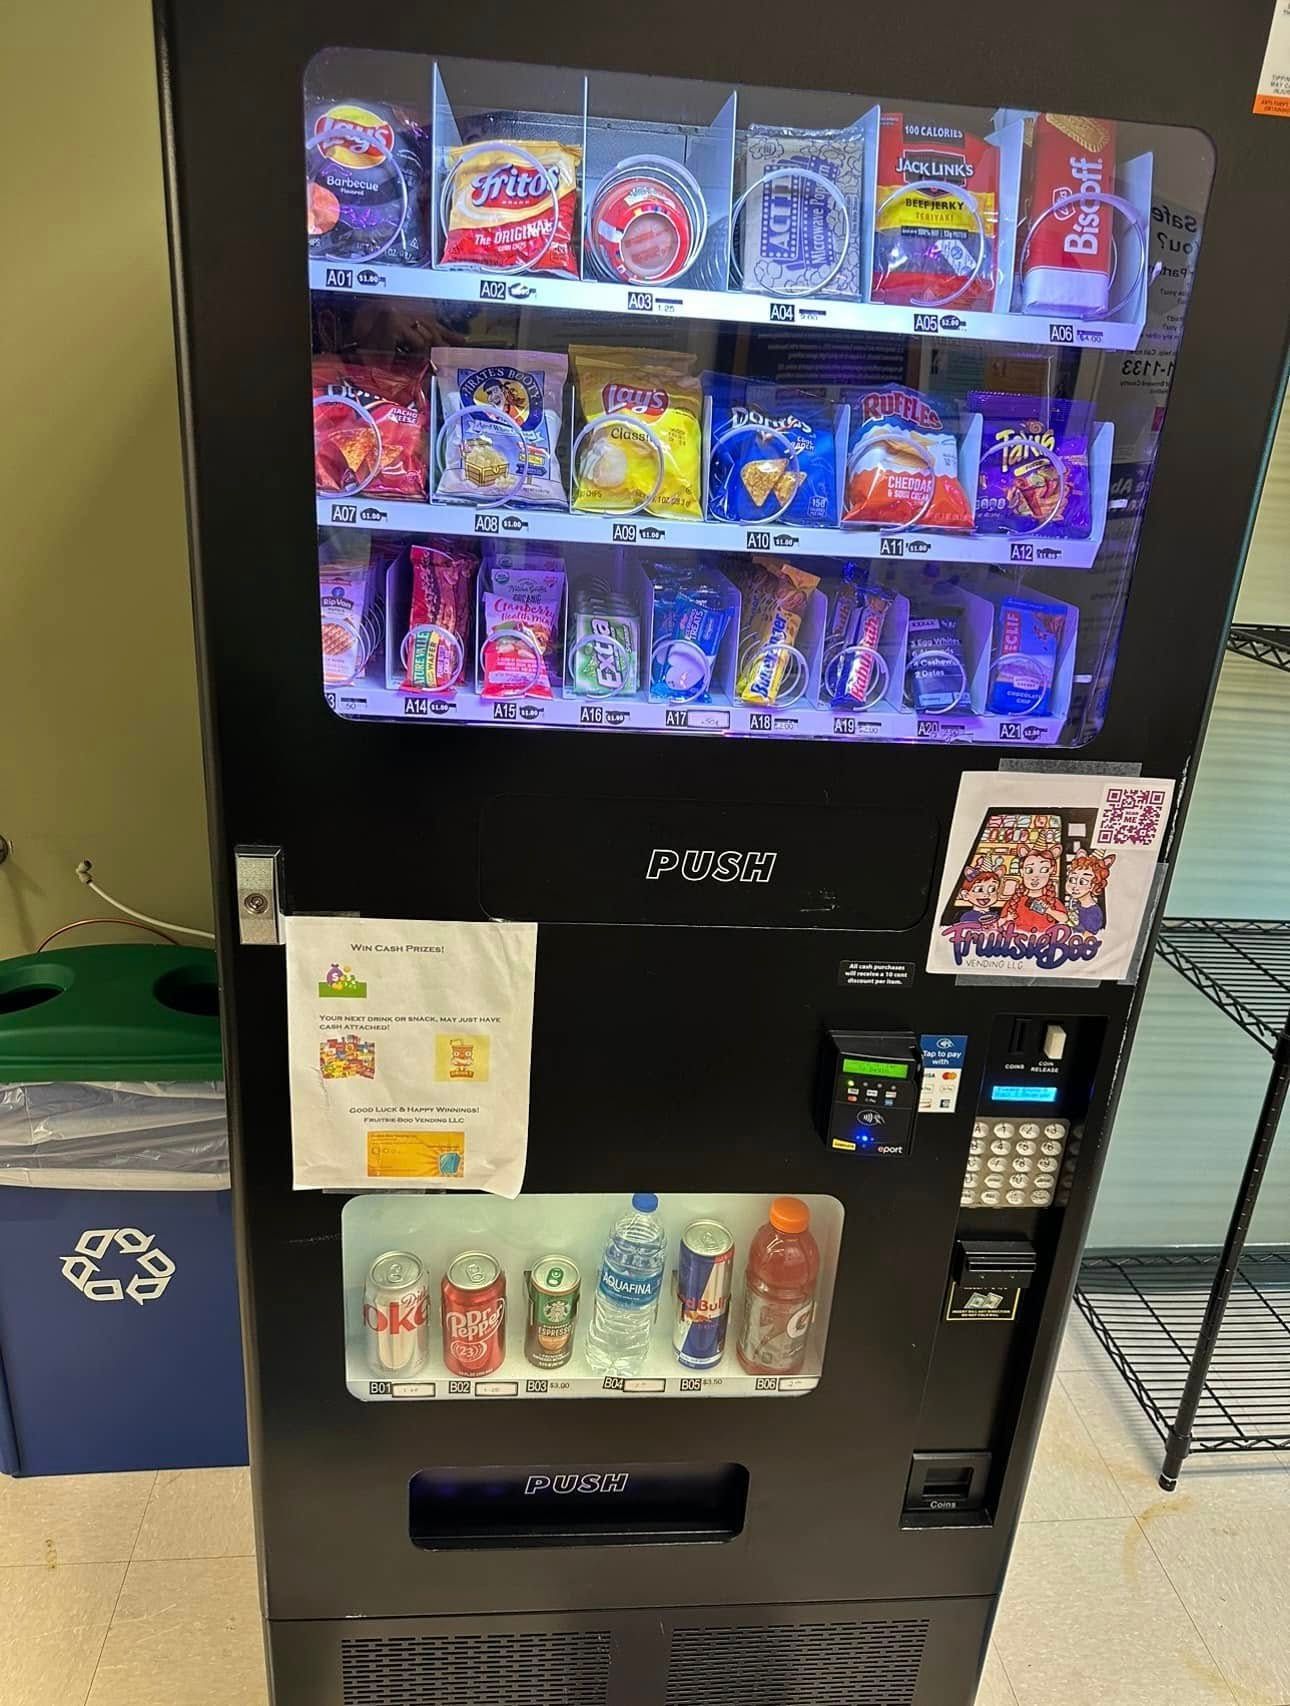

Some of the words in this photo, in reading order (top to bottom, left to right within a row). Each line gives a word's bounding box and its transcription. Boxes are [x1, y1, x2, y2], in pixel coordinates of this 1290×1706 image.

[905, 125, 920, 137] 100
[921, 126, 963, 139] CALORIES
[896, 157, 931, 176] JACK
[931, 158, 974, 178] LINK'S
[326, 175, 380, 192] Barbecue
[472, 163, 561, 207] Fritos
[905, 198, 930, 210] BEEF
[931, 200, 964, 211] JERKY
[1063, 157, 1103, 255] Biscoff
[768, 199, 792, 250] ACT
[474, 233, 491, 246] The
[810, 207, 828, 265] Microwave
[327, 271, 352, 287] A01
[481, 283, 505, 298] A02
[629, 294, 652, 309] A03
[770, 306, 794, 320] A04
[914, 316, 938, 331] A05
[1051, 326, 1073, 342] A06
[508, 369, 540, 399] BOOTY
[604, 384, 665, 413] Lay's
[862, 391, 943, 430] RUFFLES
[333, 506, 356, 522] A07
[475, 517, 498, 531] A08
[614, 526, 636, 541] A09
[747, 534, 769, 549] A10
[881, 540, 903, 555] A11
[1011, 546, 1033, 560] A12
[405, 699, 428, 714] A14
[494, 704, 516, 718] A15
[581, 709, 602, 722] A16
[666, 712, 687, 726] A17
[750, 716, 771, 729] A18
[834, 719, 854, 733] A19
[1001, 723, 1021, 739] A21
[645, 849, 777, 883] PUSH
[966, 959, 1005, 969] VENDING
[1007, 960, 1024, 969] LLC
[923, 1050, 936, 1060] Tap
[947, 1051, 962, 1060] pay
[877, 1145, 903, 1154] eport
[602, 1270, 652, 1295] AQUAFINA
[446, 1303, 503, 1341] Pepper
[466, 1308, 492, 1326] Dr
[459, 1346, 474, 1358] 23
[370, 1382, 391, 1394] B01
[449, 1382, 470, 1393] B02
[527, 1381, 547, 1392] B03
[604, 1377, 624, 1389] B04
[681, 1379, 701, 1391] B05
[757, 1379, 776, 1390] B06
[525, 1473, 629, 1494] PUSH
[930, 1501, 957, 1509] Coins
